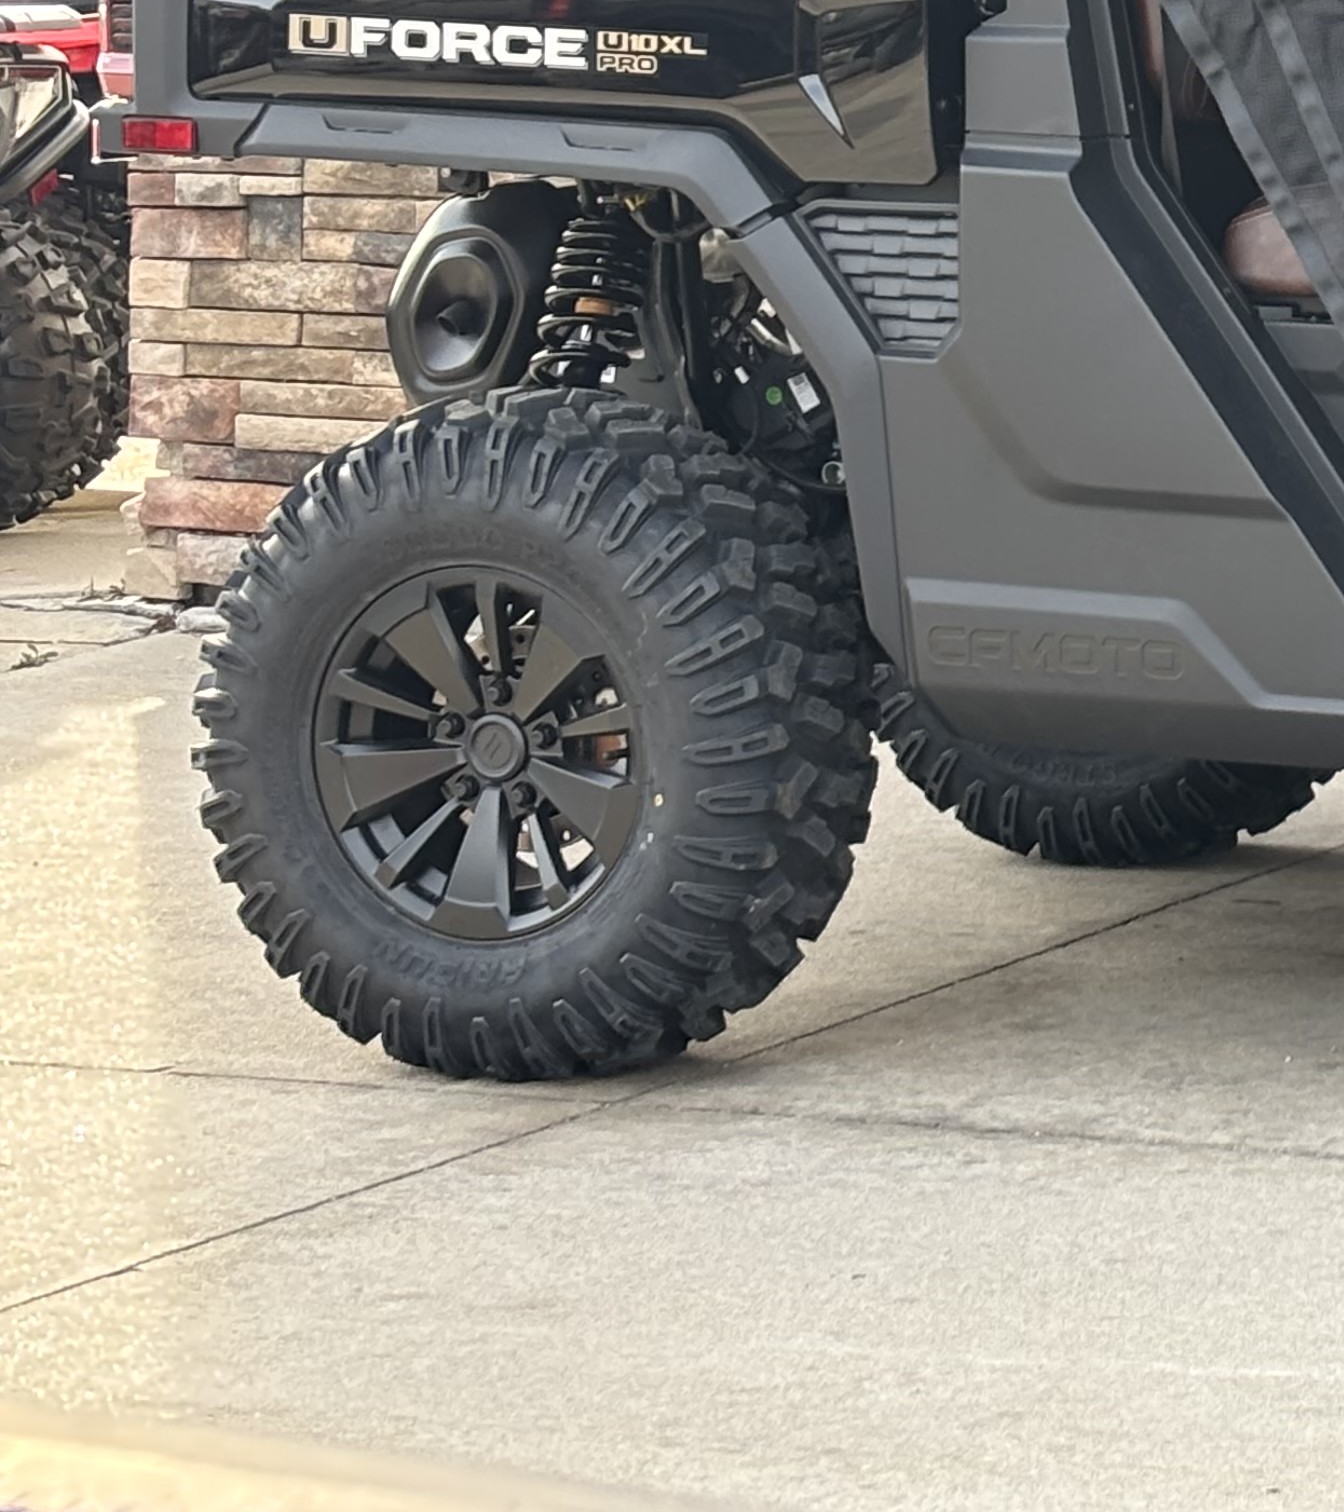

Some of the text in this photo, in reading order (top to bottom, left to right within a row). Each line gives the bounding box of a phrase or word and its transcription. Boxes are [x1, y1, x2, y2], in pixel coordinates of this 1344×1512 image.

[288, 13, 588, 71] UFORCE
[597, 53, 658, 74] PRO
[927, 625, 1185, 680] CFMOTO
